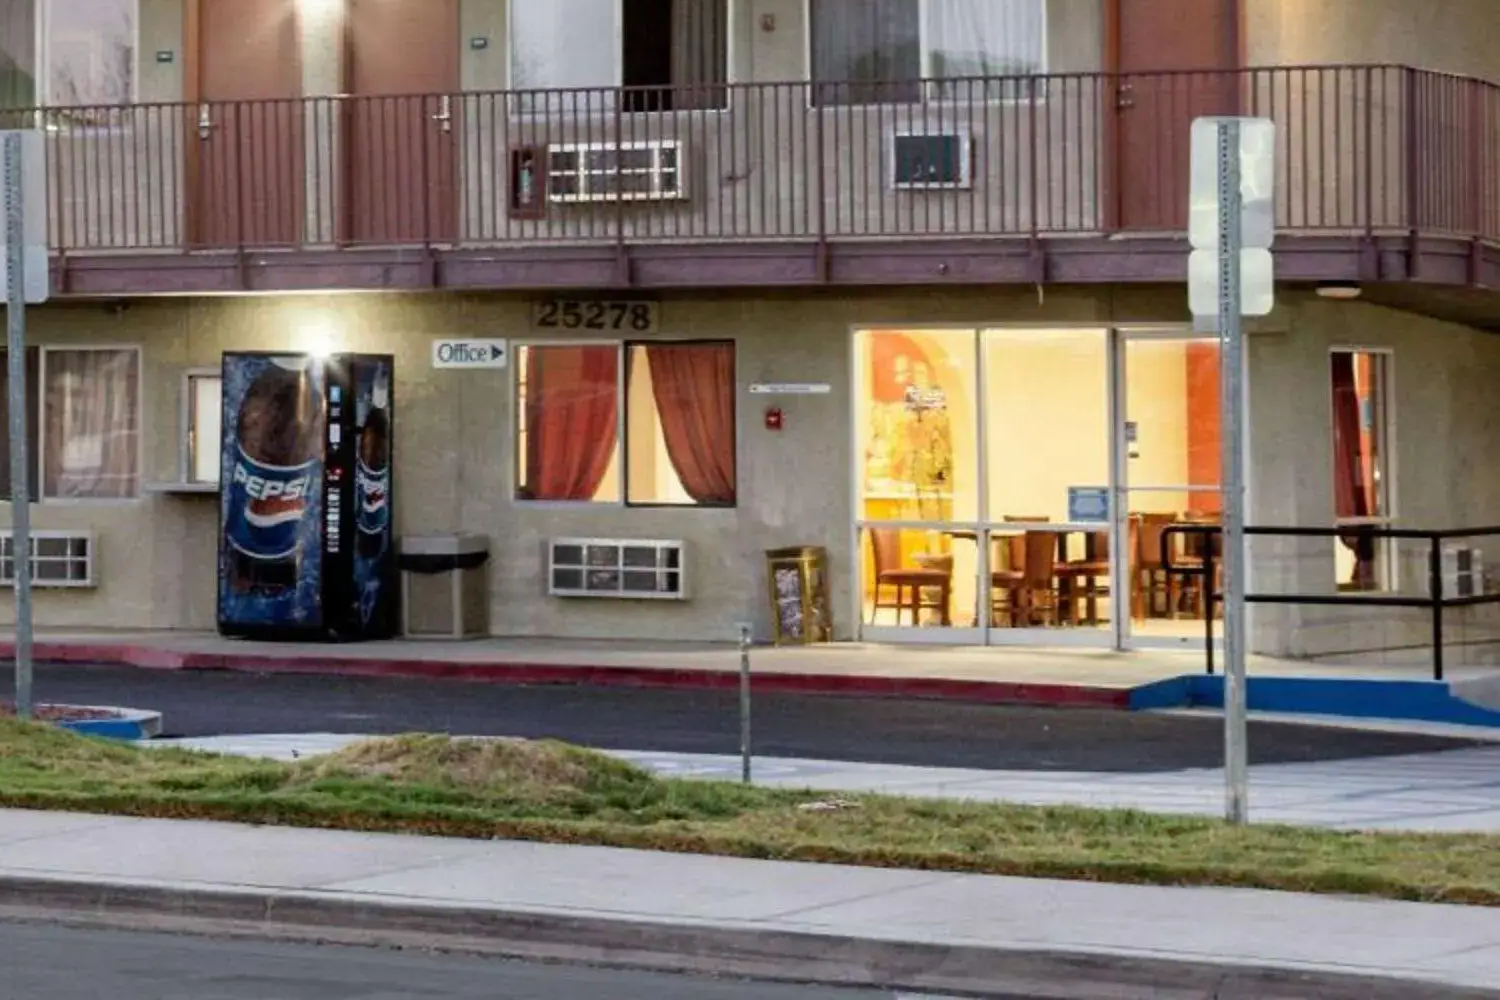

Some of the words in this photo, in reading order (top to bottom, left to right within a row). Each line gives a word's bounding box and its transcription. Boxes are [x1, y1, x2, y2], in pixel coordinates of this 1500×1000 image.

[536, 302, 650, 331] 25278
[437, 343, 488, 363] Office
[234, 462, 311, 501] PEPSI
